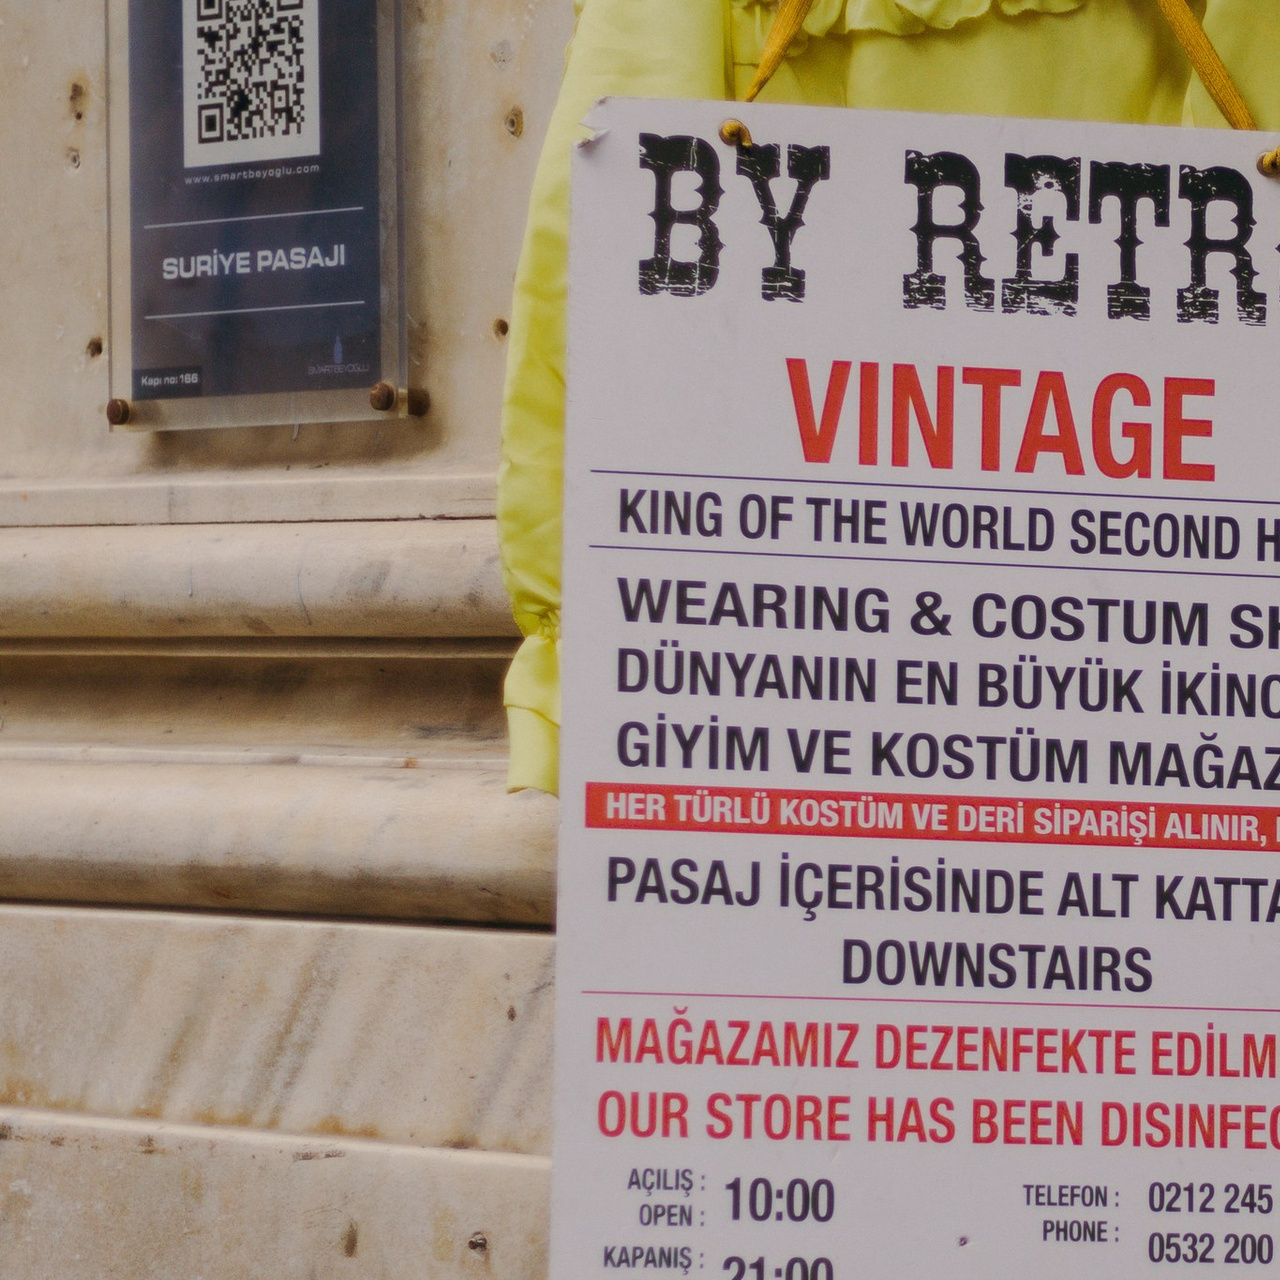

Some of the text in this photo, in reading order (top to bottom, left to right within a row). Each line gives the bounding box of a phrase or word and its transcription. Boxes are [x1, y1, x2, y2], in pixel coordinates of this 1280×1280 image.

[638, 132, 830, 303] BY
[162, 244, 346, 280] SURİYE PASAJI
[785, 357, 1216, 483] VINTAGE
[619, 488, 724, 538] KING
[740, 493, 794, 542] OF
[806, 497, 887, 547] THE
[900, 502, 1056, 553] WORLD
[1070, 508, 1241, 561] SECOND
[617, 577, 890, 634] WEARING
[909, 590, 953, 636] &
[972, 592, 1209, 647] COSTUM
[617, 639, 876, 703] DÜNYANIN
[896, 659, 958, 706] EN
[978, 654, 1145, 714] BÜYÜK
[617, 712, 769, 772] GİYİM
[786, 728, 851, 775] VE
[871, 726, 1088, 784] KOSTÜM
[606, 792, 666, 822] HER
[673, 789, 770, 826] TÜRLÜ
[780, 796, 903, 830] KOSTÜM
[911, 803, 948, 831] VE
[957, 801, 1024, 834] DERİ
[1034, 802, 1156, 846] SİPARİŞİ
[1164, 812, 1268, 847] ALINIR,
[607, 856, 760, 907] PASAJ
[779, 852, 1044, 921] İÇERİSİNDE
[1056, 871, 1139, 918] ALT
[842, 938, 1153, 993] DOWNSTAIRS
[595, 1005, 860, 1069] MAĞAZAMIZ
[875, 1024, 1136, 1075] DEZENFEKTE
[598, 1090, 690, 1138] OUR
[705, 1092, 851, 1141] STORE
[866, 1096, 956, 1144] HAS
[972, 1098, 1084, 1146] BEEN
[627, 1168, 694, 1197] AÇILIŞ
[725, 1177, 835, 1223] 10:00
[1022, 1184, 1108, 1208] TELEFON
[1148, 1181, 1215, 1214] 0212
[1223, 1183, 1273, 1215] 245
[639, 1204, 693, 1227] OPEN
[1042, 1219, 1108, 1243] PHONE
[603, 1246, 693, 1276] KAPANIŞ
[1148, 1232, 1215, 1264] 0532
[1223, 1233, 1274, 1265] 200
